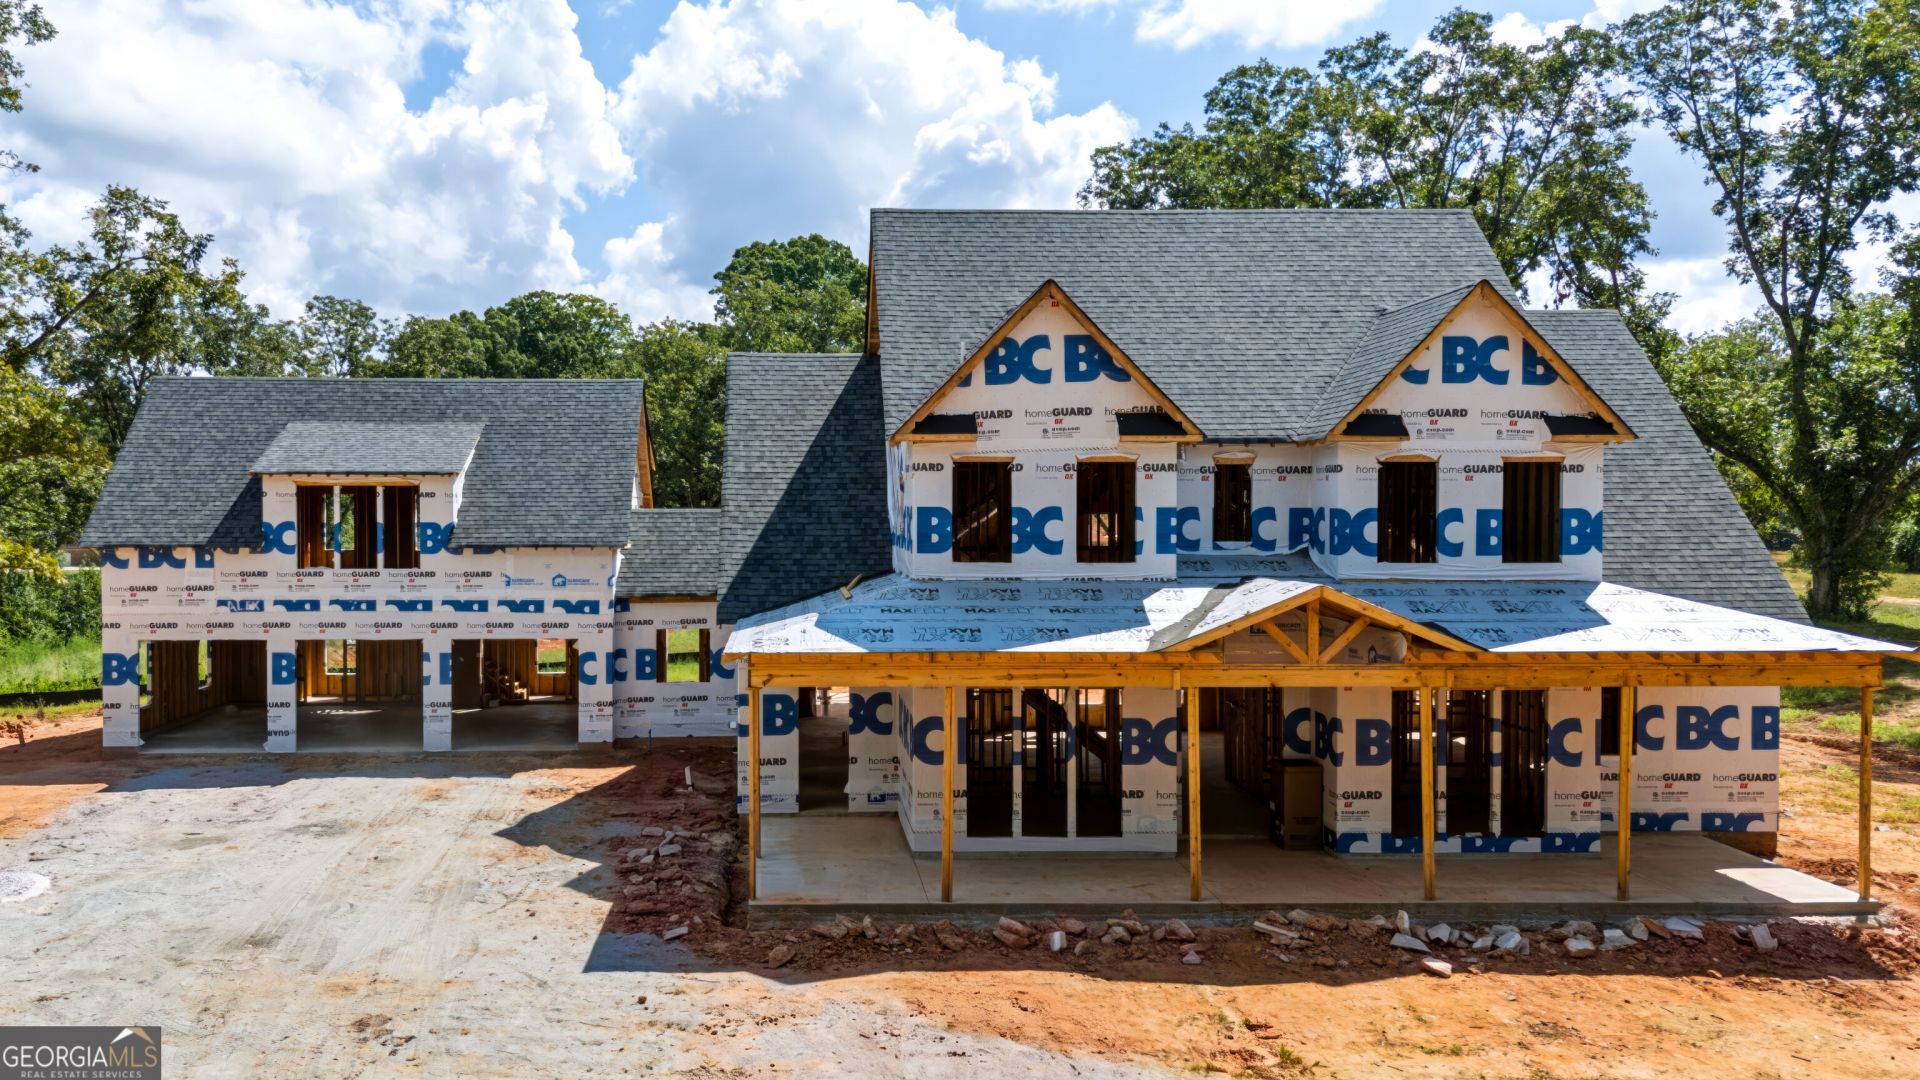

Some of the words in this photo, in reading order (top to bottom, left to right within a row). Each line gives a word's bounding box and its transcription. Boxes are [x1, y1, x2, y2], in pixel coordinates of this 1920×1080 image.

[985, 335, 1052, 385] BC
[1442, 335, 1510, 386] BC
[1025, 407, 1093, 418] homeGUARD
[1400, 408, 1468, 418] homeGUARD
[1036, 463, 1078, 472] homeGU
[1676, 704, 1740, 751] BC
[1637, 772, 1701, 782] homeGUARD
[1713, 772, 1777, 782] homeGUARD
[1554, 790, 1600, 801] homeGUA
